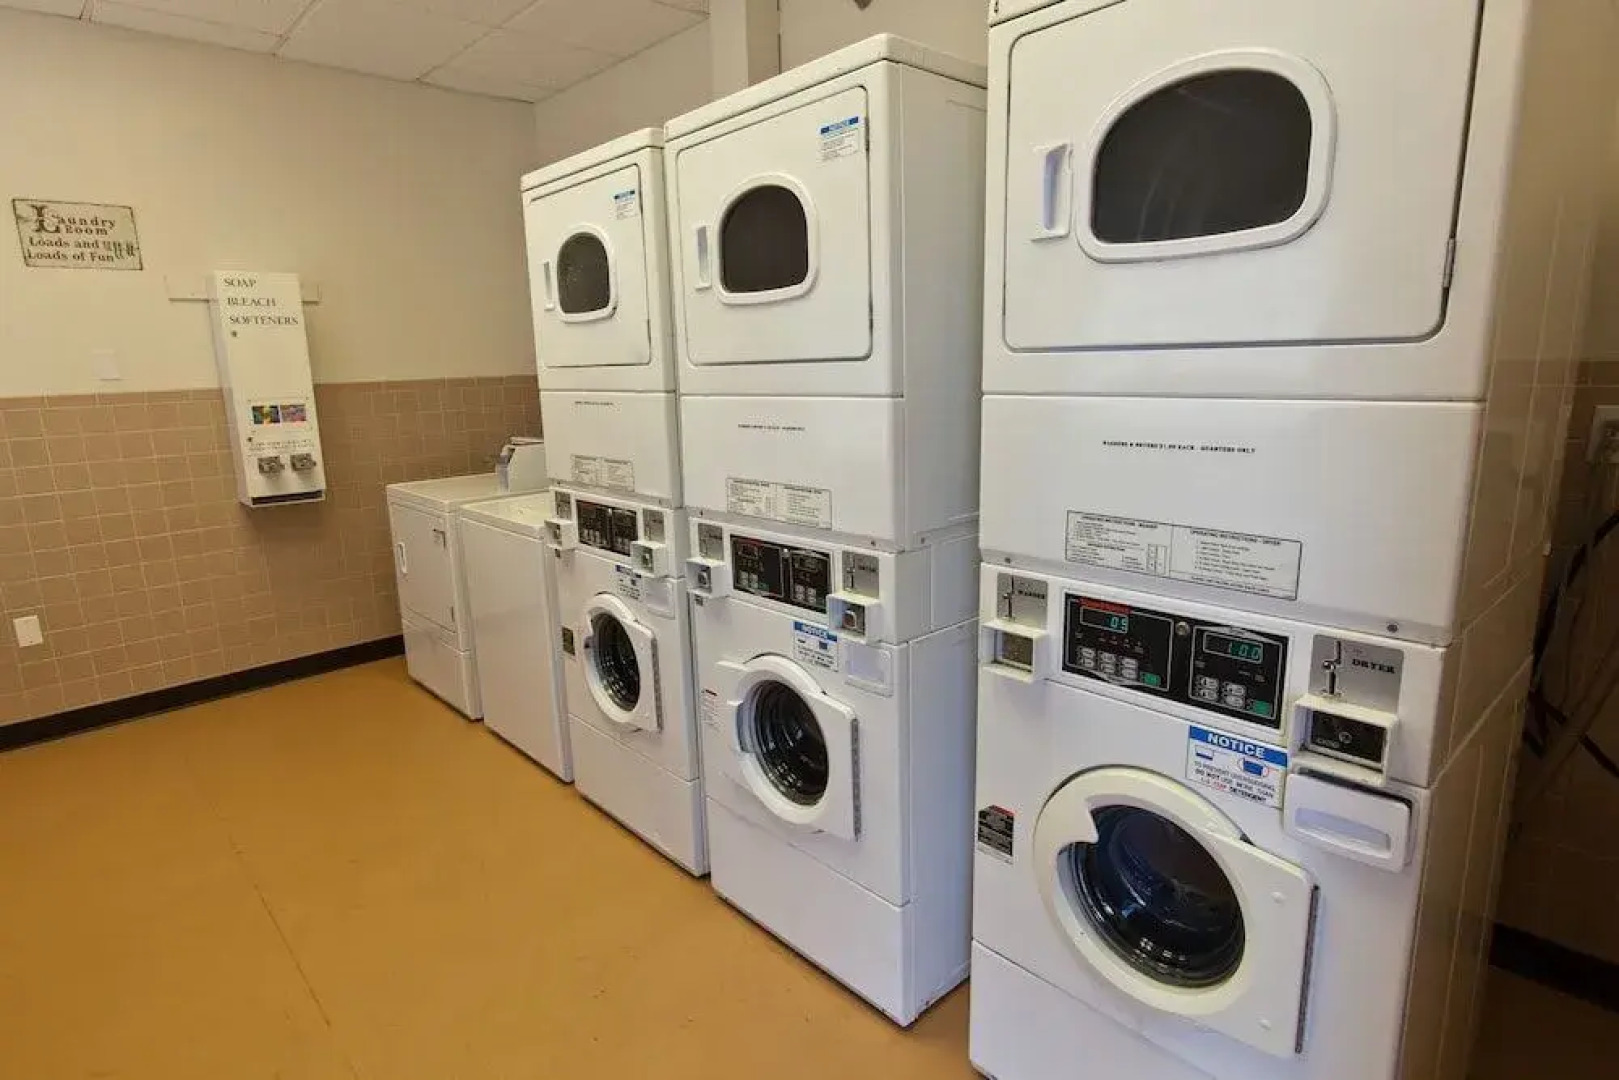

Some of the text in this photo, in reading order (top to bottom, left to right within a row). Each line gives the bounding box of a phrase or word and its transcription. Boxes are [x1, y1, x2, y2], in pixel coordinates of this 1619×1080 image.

[29, 237, 100, 249] Loads and
[27, 249, 114, 263] Loads of Fun
[223, 278, 257, 288] SOAP
[227, 297, 276, 307] BLEACH
[230, 315, 299, 325] SOFTENERS
[1352, 658, 1395, 674] DRYER
[1207, 733, 1265, 759] NOTICE
